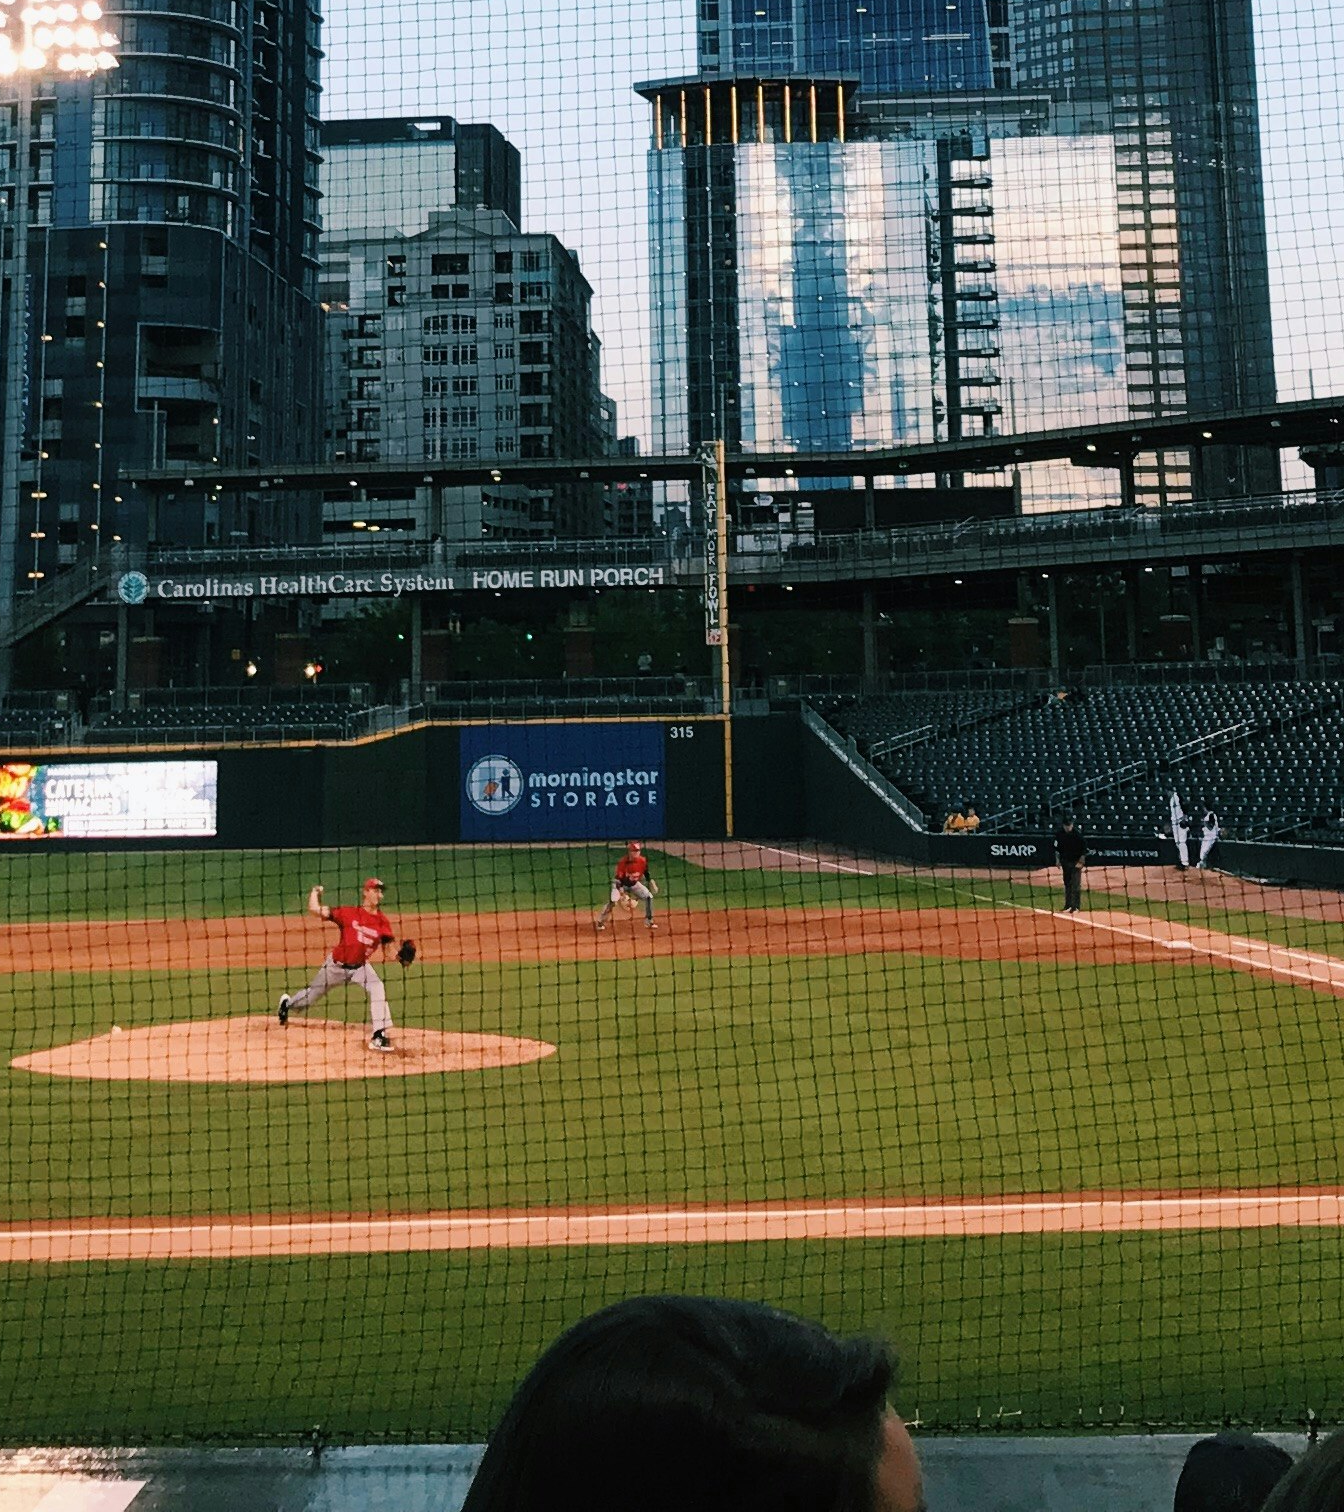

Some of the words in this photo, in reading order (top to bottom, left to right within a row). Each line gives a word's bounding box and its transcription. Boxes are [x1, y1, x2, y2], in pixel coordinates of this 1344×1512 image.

[157, 578, 254, 598] Carolinas
[260, 574, 374, 594] HealthCare
[380, 572, 455, 597] System
[473, 570, 534, 589] HOME
[540, 569, 584, 588] RUN
[590, 567, 664, 587] PORCH
[670, 726, 694, 738] 315
[45, 778, 120, 798] CATERIN
[528, 767, 659, 792] morningstar
[531, 790, 658, 808] STORAGE
[991, 845, 1037, 857] SHARP
